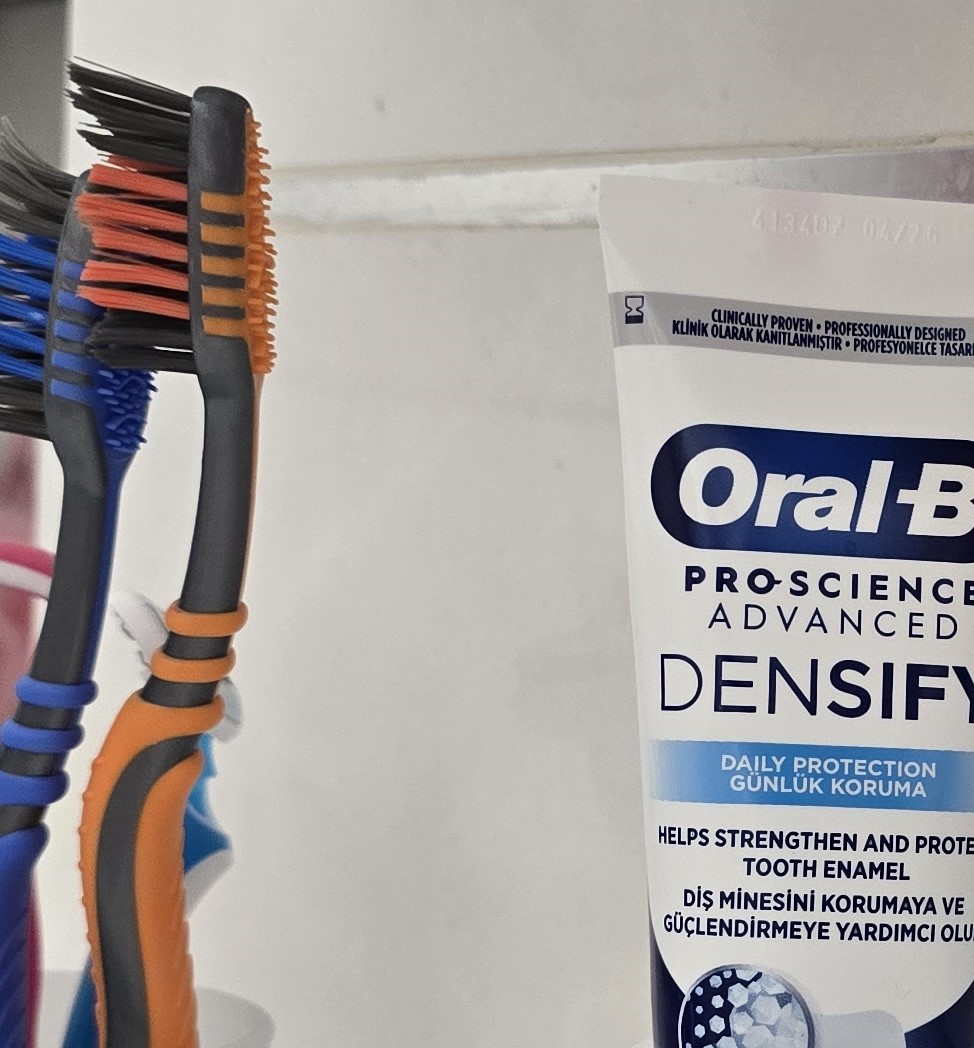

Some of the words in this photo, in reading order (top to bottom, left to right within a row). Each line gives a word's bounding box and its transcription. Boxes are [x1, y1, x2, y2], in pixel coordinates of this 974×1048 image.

[672, 318, 708, 337] KLİNİK
[711, 324, 753, 342] OLARAK
[755, 328, 842, 351] KANITLANMIŞTIR
[853, 338, 937, 356] PROFESYONELCE
[711, 308, 769, 328] CLINICALLY
[771, 315, 813, 333] PROVEN
[824, 320, 912, 340] PROFESSIONALLY
[914, 326, 966, 342] DESIGNED
[708, 602, 958, 640] ADVANCED
[720, 754, 787, 773] DAILY
[793, 757, 937, 779] PROTECTION
[729, 772, 824, 794] GÜNLÜK
[831, 778, 927, 797] KORUMA
[658, 825, 710, 846] HELPS
[714, 829, 858, 851] STRENGTHEN
[863, 834, 910, 853] AND
[743, 857, 817, 878] TOOTH
[823, 861, 911, 881] ENAMEL
[683, 885, 714, 911] DİŞ
[719, 888, 816, 912] MİNESİNİ
[821, 894, 937, 915] KORUMAYA
[942, 897, 965, 916] VE
[663, 911, 831, 940] GÜÇLENDİRMEYE
[835, 922, 936, 943] YARDIMCI
